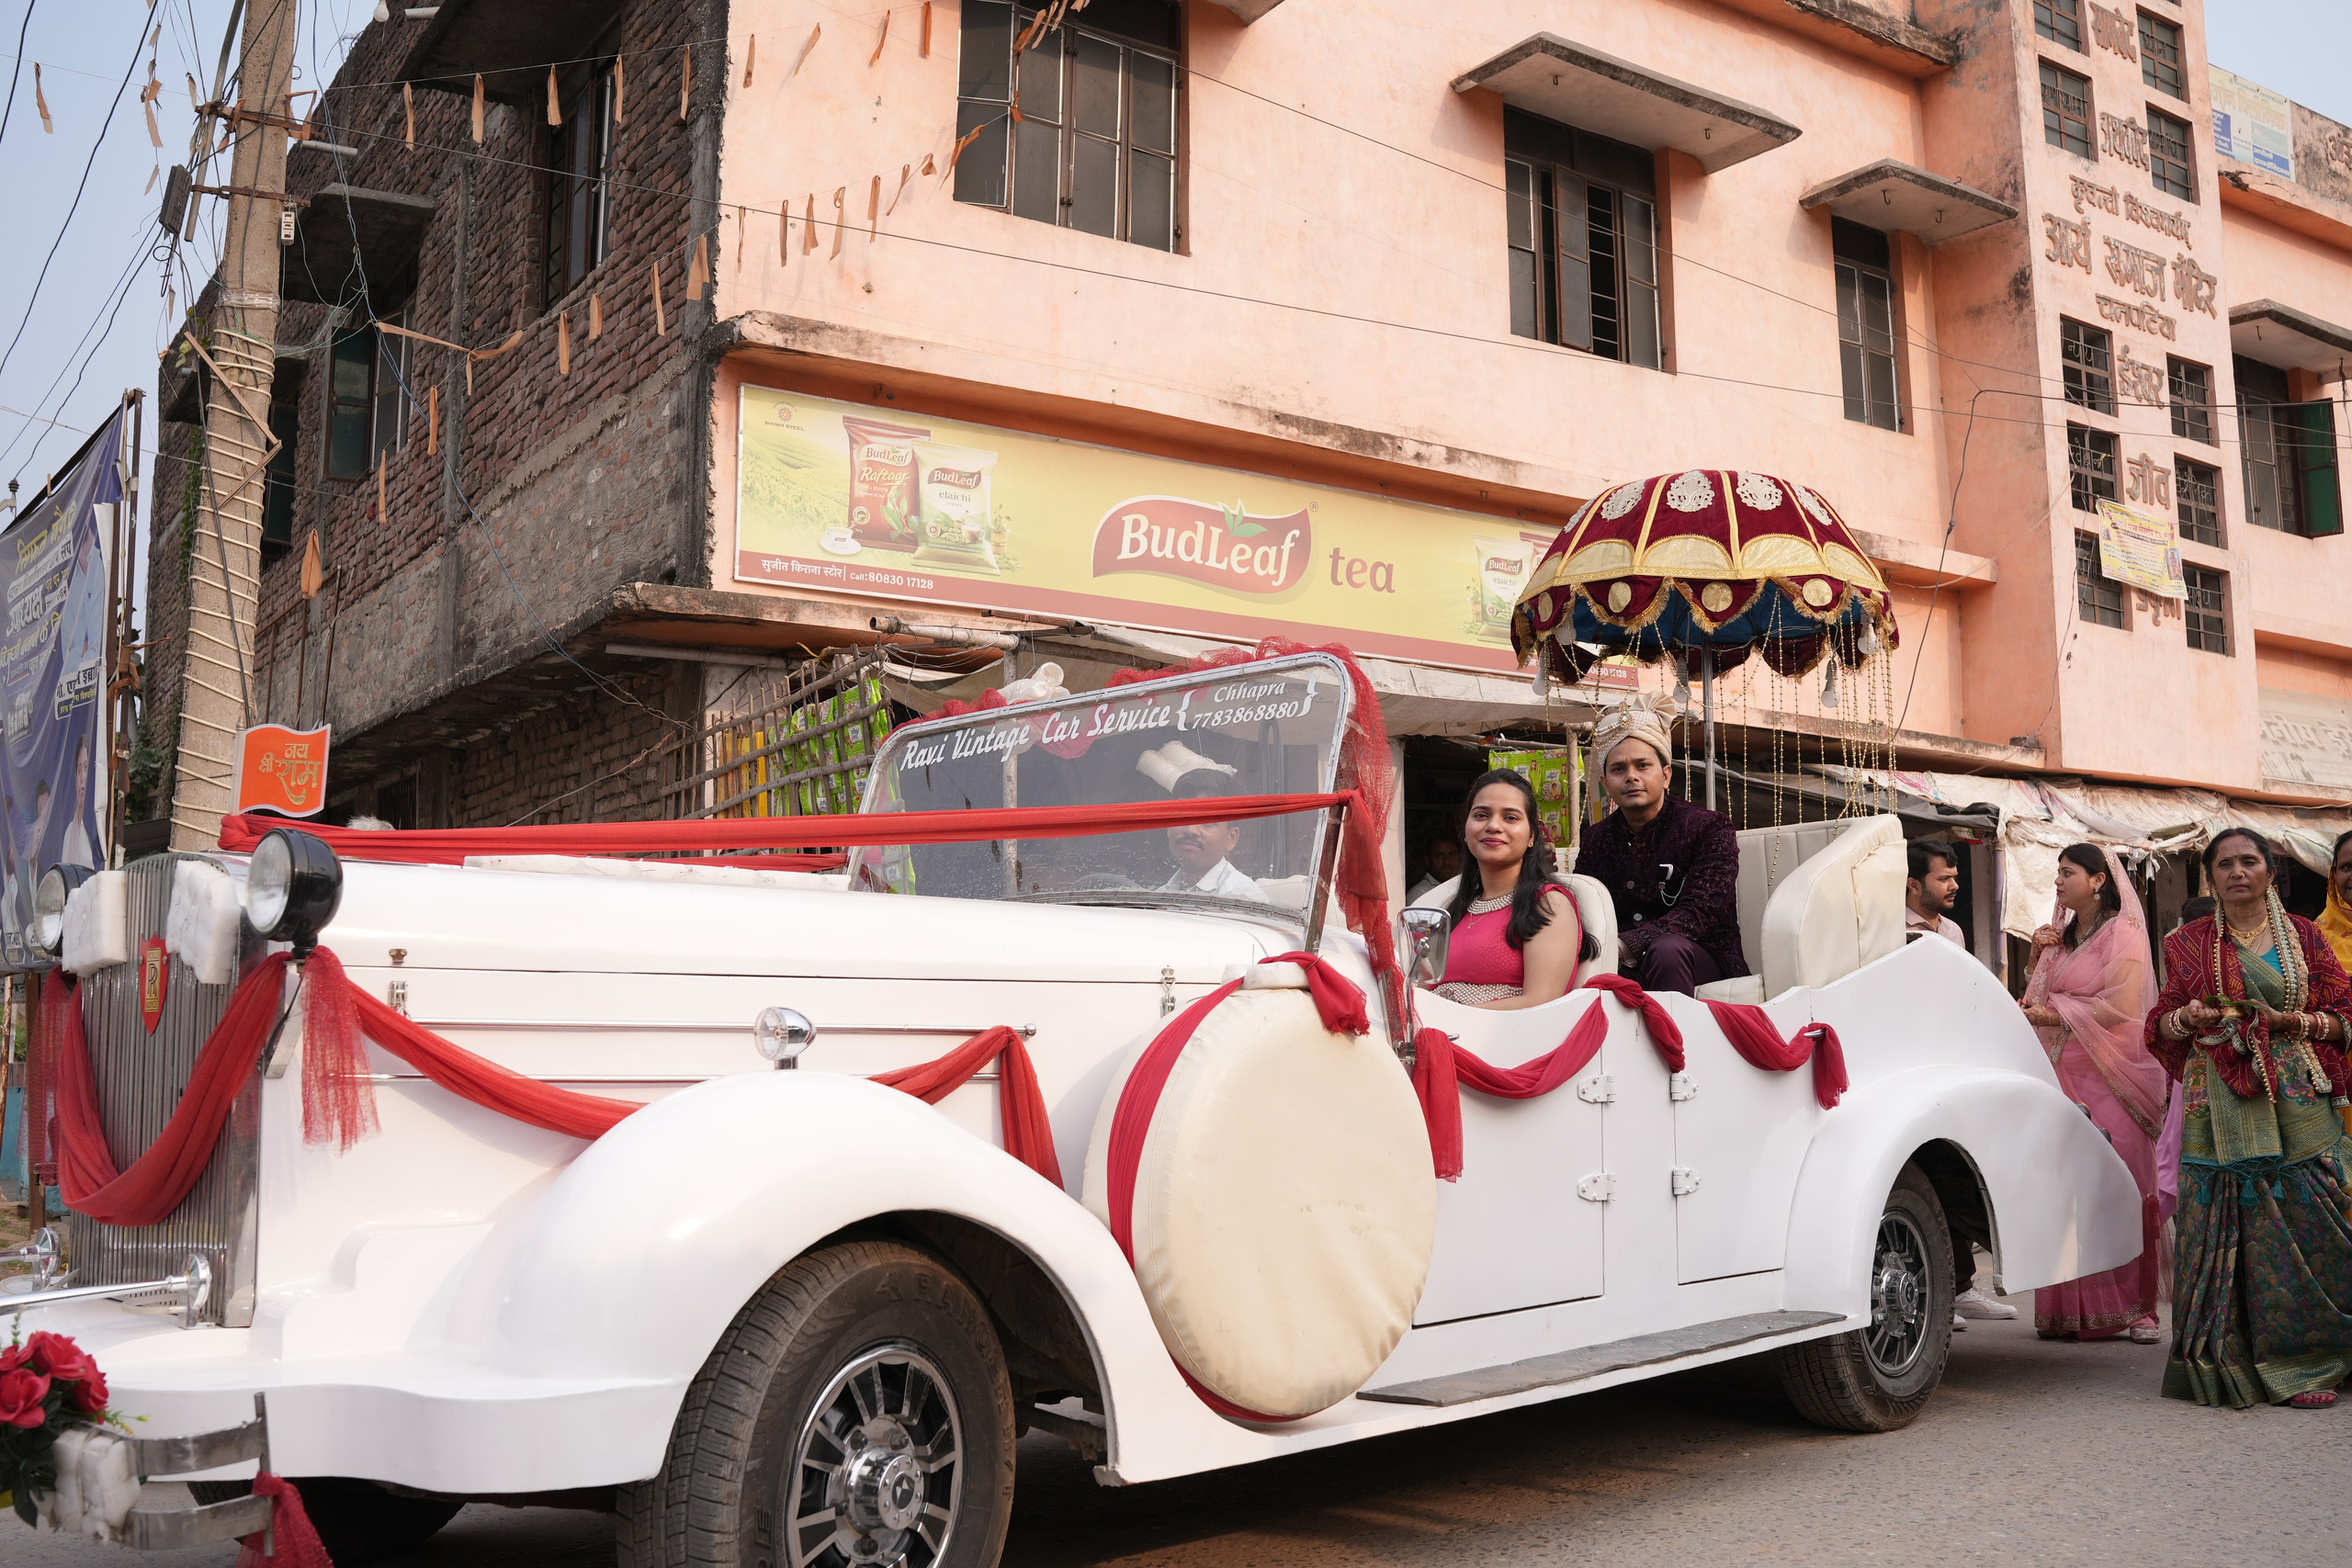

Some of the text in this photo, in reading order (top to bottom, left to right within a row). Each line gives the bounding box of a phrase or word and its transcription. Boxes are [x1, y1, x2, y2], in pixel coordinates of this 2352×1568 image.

[2041, 212, 2218, 320] आर्य समाज मंदिर
[2096, 293, 2177, 341] चनपटिया
[2117, 344, 2165, 410] ईश्वर
[865, 446, 910, 465] BudLeaf
[933, 469, 979, 488] BudLeaf
[2126, 452, 2172, 510] जीव
[939, 491, 971, 503] elaichi
[1116, 513, 1396, 594] BudLeaf tea
[1488, 558, 1521, 574] BudLeaf
[761, 558, 788, 572] सुजीत
[790, 560, 820, 575] किराना
[823, 565, 842, 578] स्टोर
[906, 577, 934, 590] 17128
[1493, 577, 1517, 587] elaichi
[1214, 680, 1286, 705] Chhapra
[1193, 701, 1301, 730] 7783868880
[900, 696, 1171, 772] Ravi Vintage Car Service
[284, 743, 311, 760] जय
[258, 751, 322, 806] श्री राम
[148, 951, 160, 959] ROLLS
[146, 1000, 158, 1009] ROYCE
